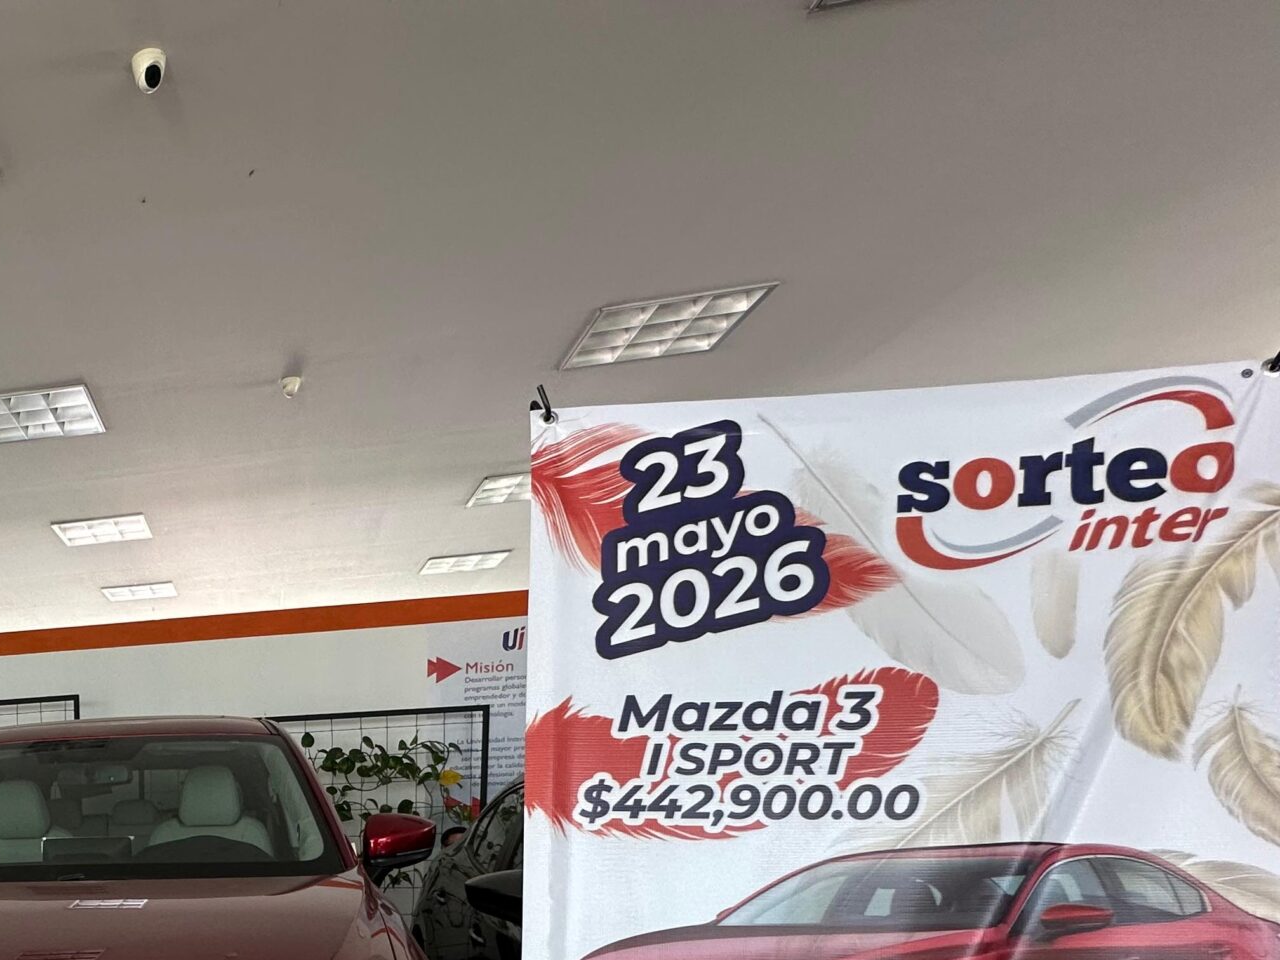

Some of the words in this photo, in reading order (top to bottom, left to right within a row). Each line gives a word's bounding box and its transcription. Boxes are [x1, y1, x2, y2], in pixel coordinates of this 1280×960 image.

[633, 433, 730, 514] 23
[896, 436, 1237, 514] sorteo
[615, 504, 780, 574] mayo
[1068, 506, 1231, 553] inter
[606, 555, 815, 647] 2026
[465, 659, 514, 674] Misión
[618, 690, 821, 732] Mazda
[835, 690, 876, 730] 3
[673, 741, 857, 777] SPORT
[577, 780, 921, 827] $442,900.00
